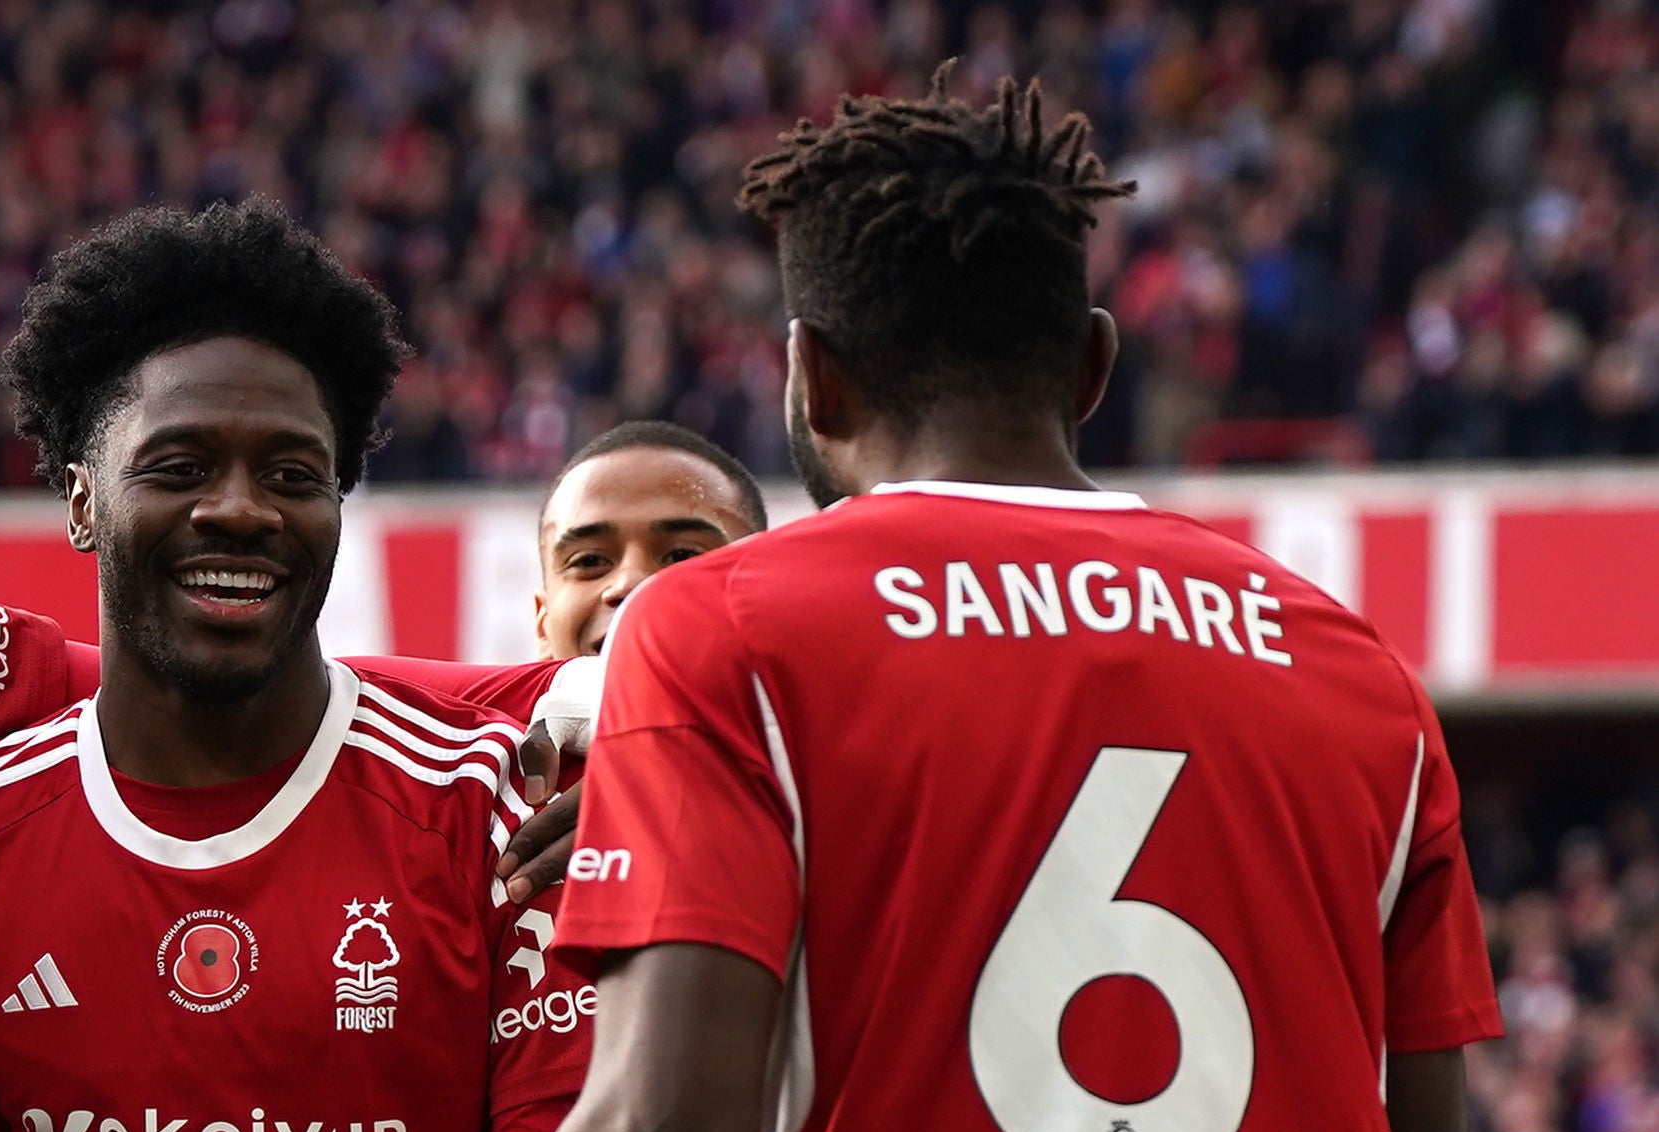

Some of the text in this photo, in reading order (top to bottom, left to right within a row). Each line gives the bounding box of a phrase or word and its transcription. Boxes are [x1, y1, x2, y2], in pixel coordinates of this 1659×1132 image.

[873, 560, 1294, 666] SANGARÉ
[568, 847, 632, 882] en
[157, 917, 187, 977] NOTTINGHAM
[185, 909, 225, 922] FOREST
[232, 918, 257, 944] ASTON
[249, 943, 260, 972] VILLA
[183, 998, 234, 1014] NOVEMBER
